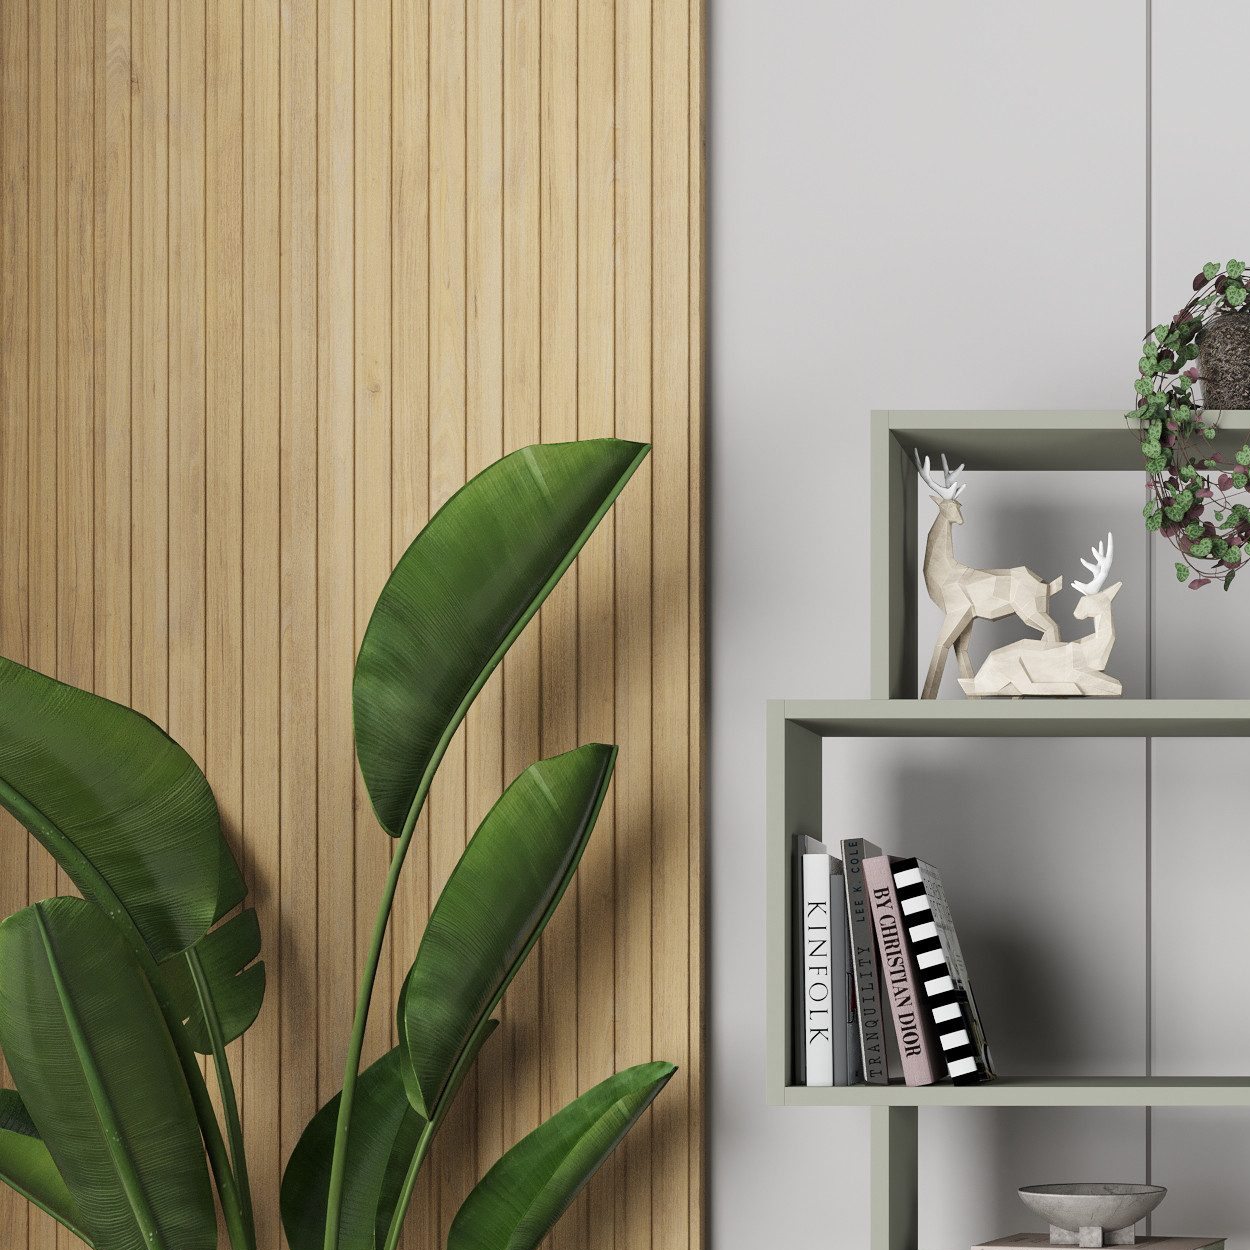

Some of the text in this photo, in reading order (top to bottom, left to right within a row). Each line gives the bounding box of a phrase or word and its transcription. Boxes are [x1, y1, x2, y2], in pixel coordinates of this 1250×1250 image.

[849, 841, 860, 873] COLE
[855, 900, 865, 922] LEE
[807, 901, 829, 1044] KINFOLK
[857, 946, 882, 1078] TRANQUILITY
[873, 886, 922, 1058] BY CHRISTIAN DIOR
